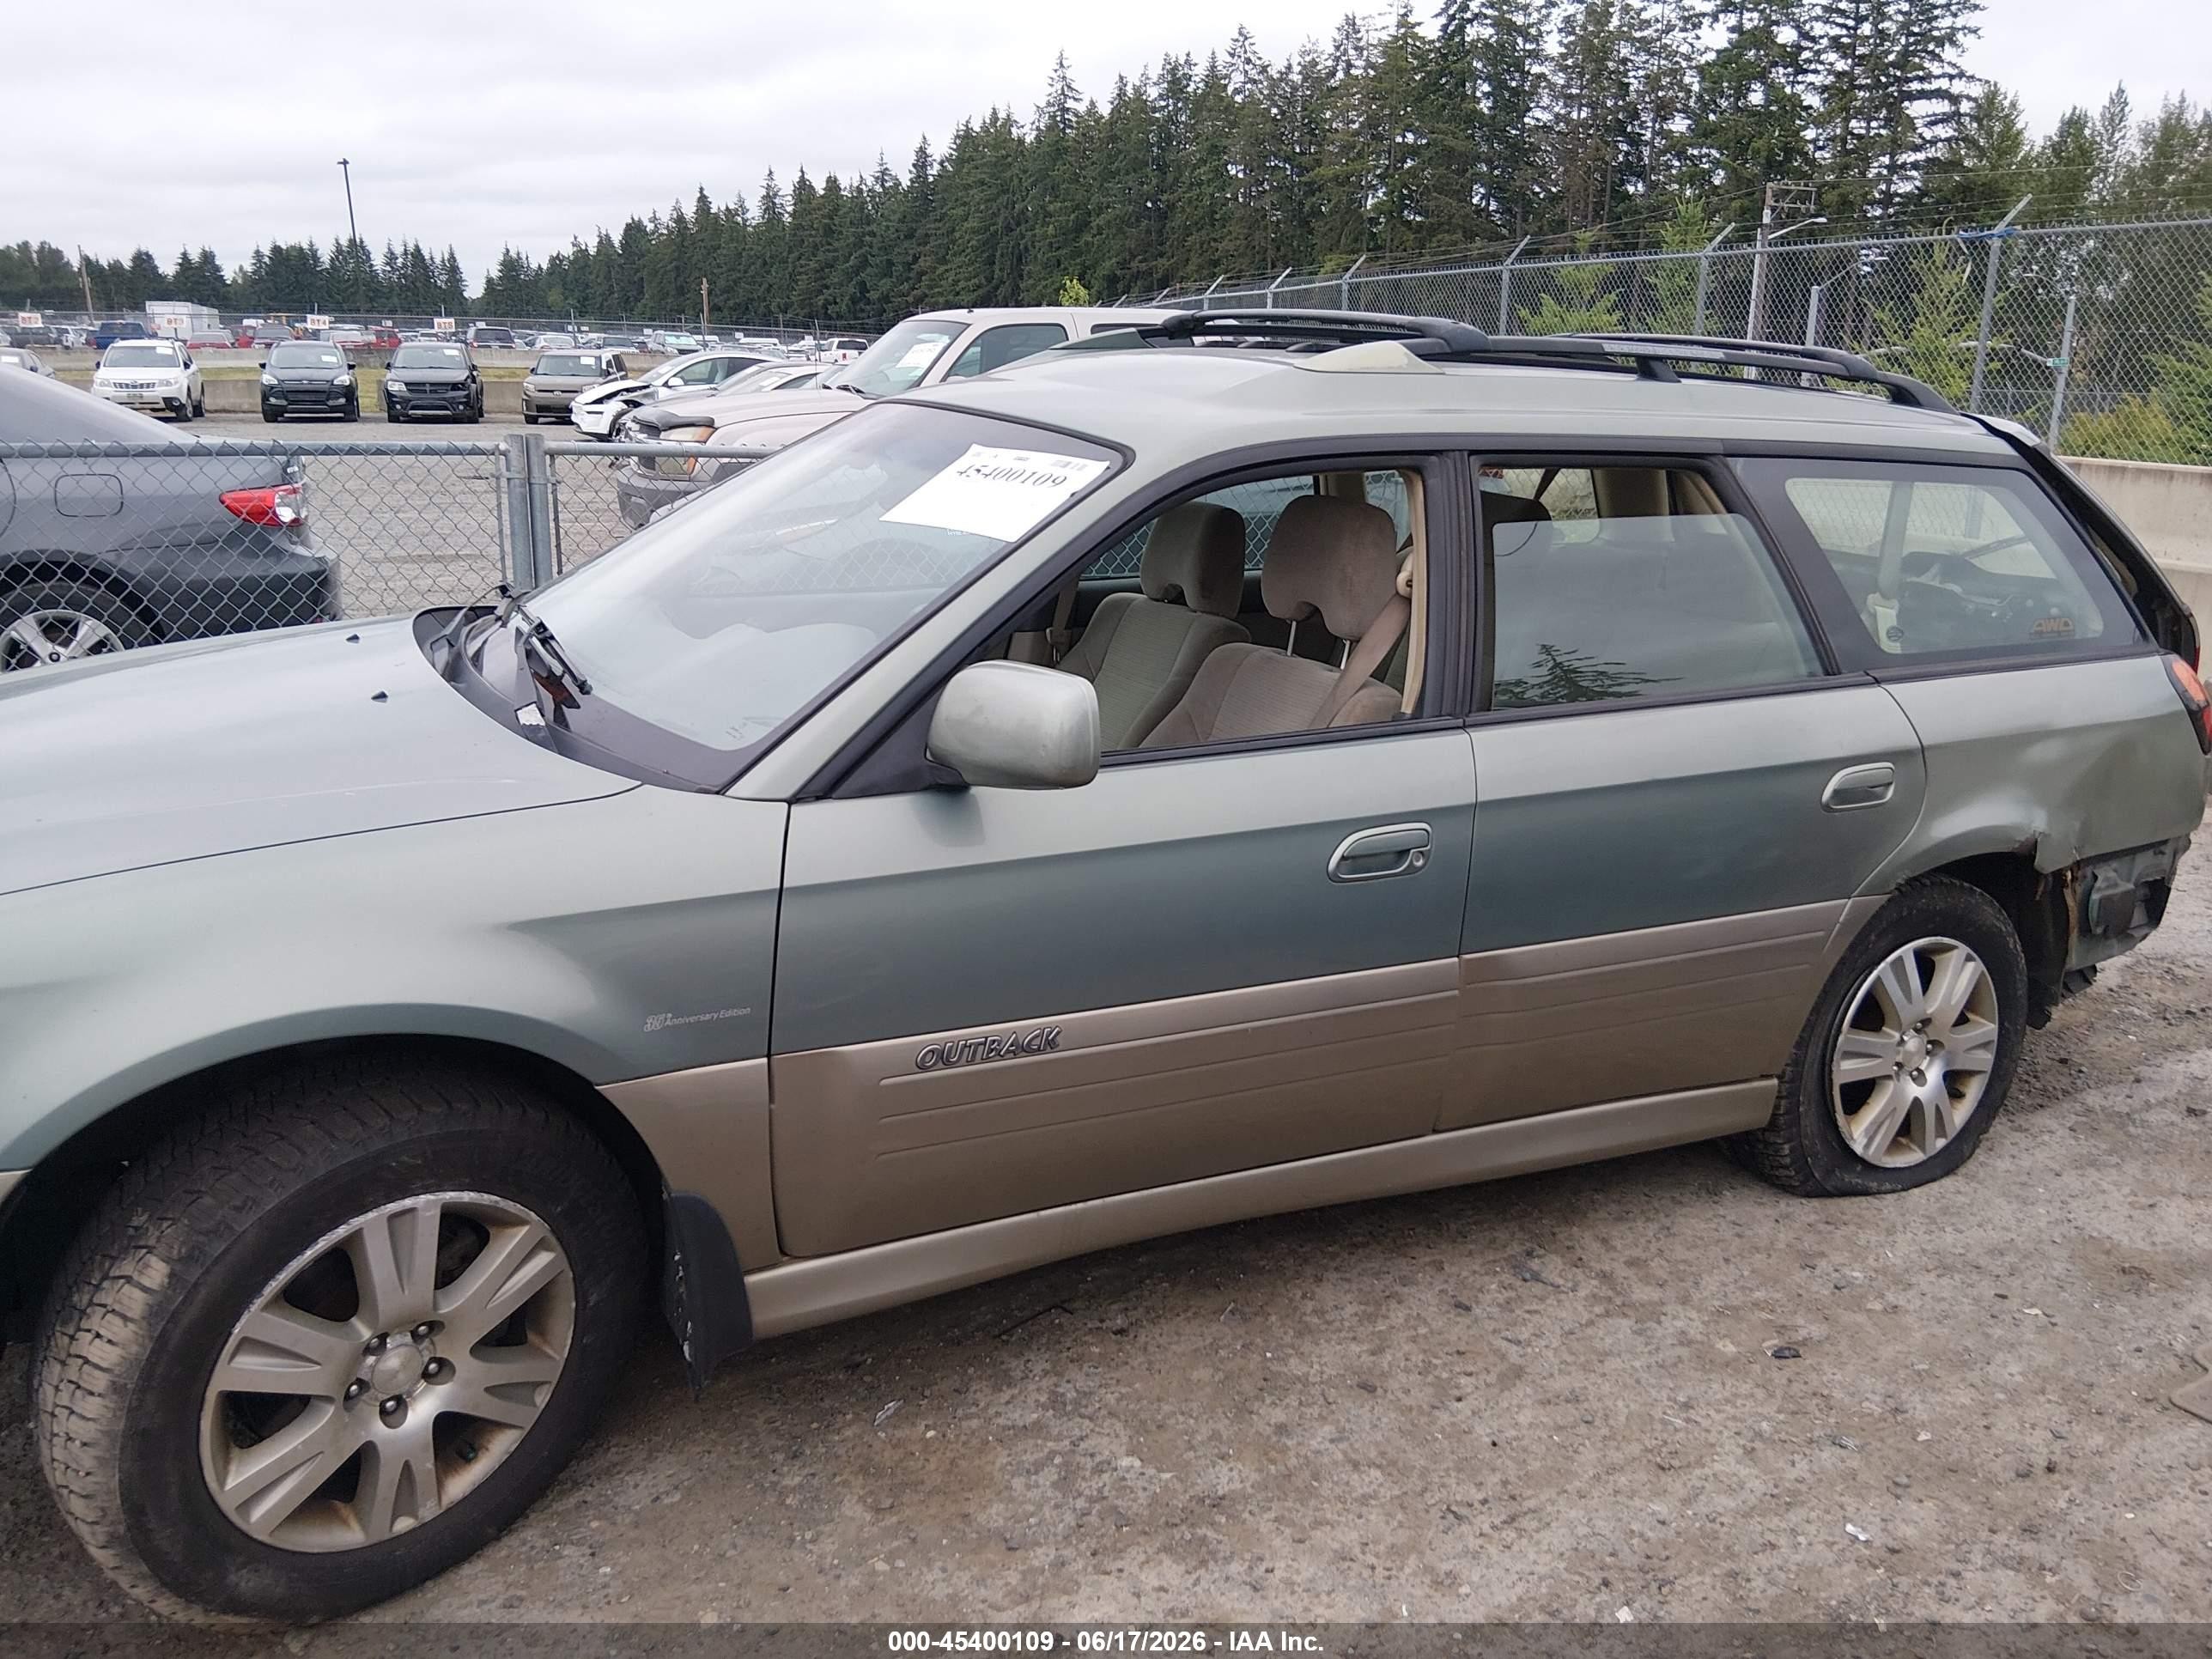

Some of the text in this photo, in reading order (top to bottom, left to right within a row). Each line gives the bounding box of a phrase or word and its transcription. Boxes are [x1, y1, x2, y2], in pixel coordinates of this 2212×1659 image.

[665, 1011, 720, 1026] Anniversary
[719, 1006, 751, 1019] Edition
[915, 1024, 1063, 1071] OUTBACK
